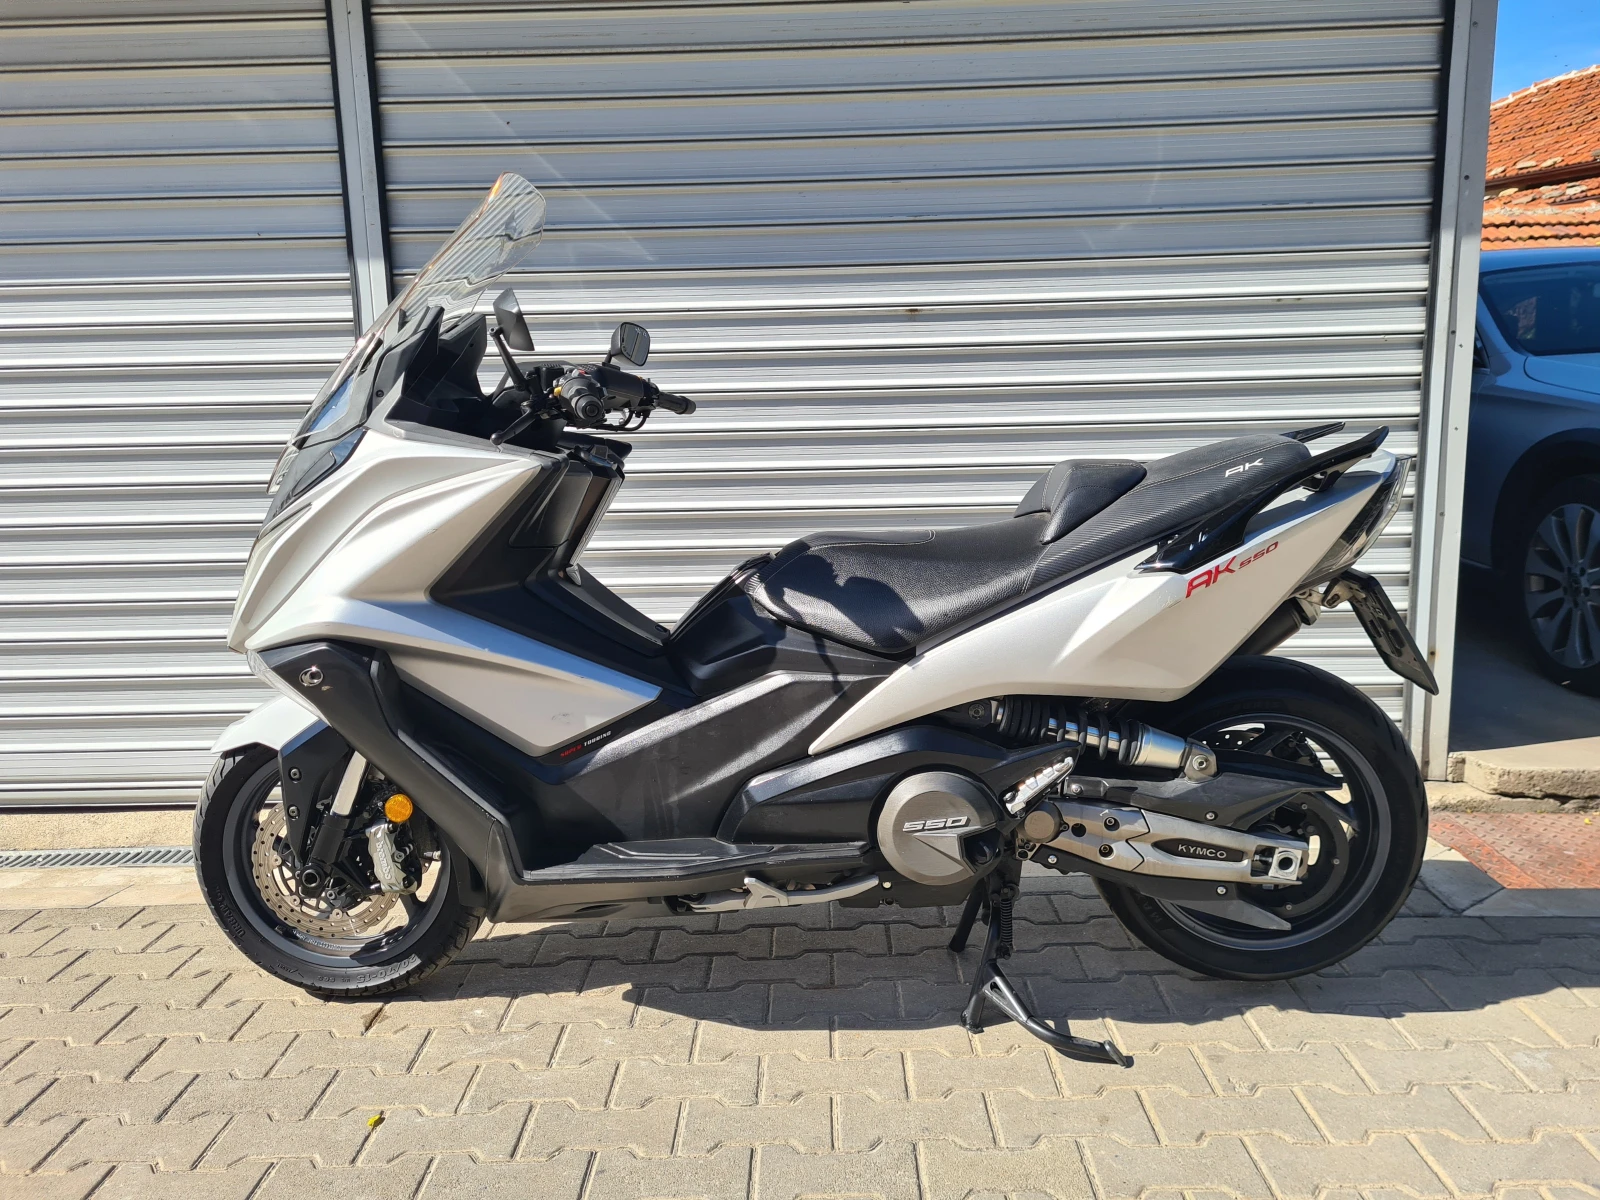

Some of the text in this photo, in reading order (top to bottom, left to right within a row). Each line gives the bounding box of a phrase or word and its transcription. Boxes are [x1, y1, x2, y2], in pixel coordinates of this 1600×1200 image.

[1225, 457, 1264, 478] AK
[1185, 541, 1279, 598] AK 550
[583, 730, 612, 747] TOURING
[902, 816, 970, 832] 550
[376, 840, 391, 880] brembo
[1178, 844, 1227, 859] KYMCO
